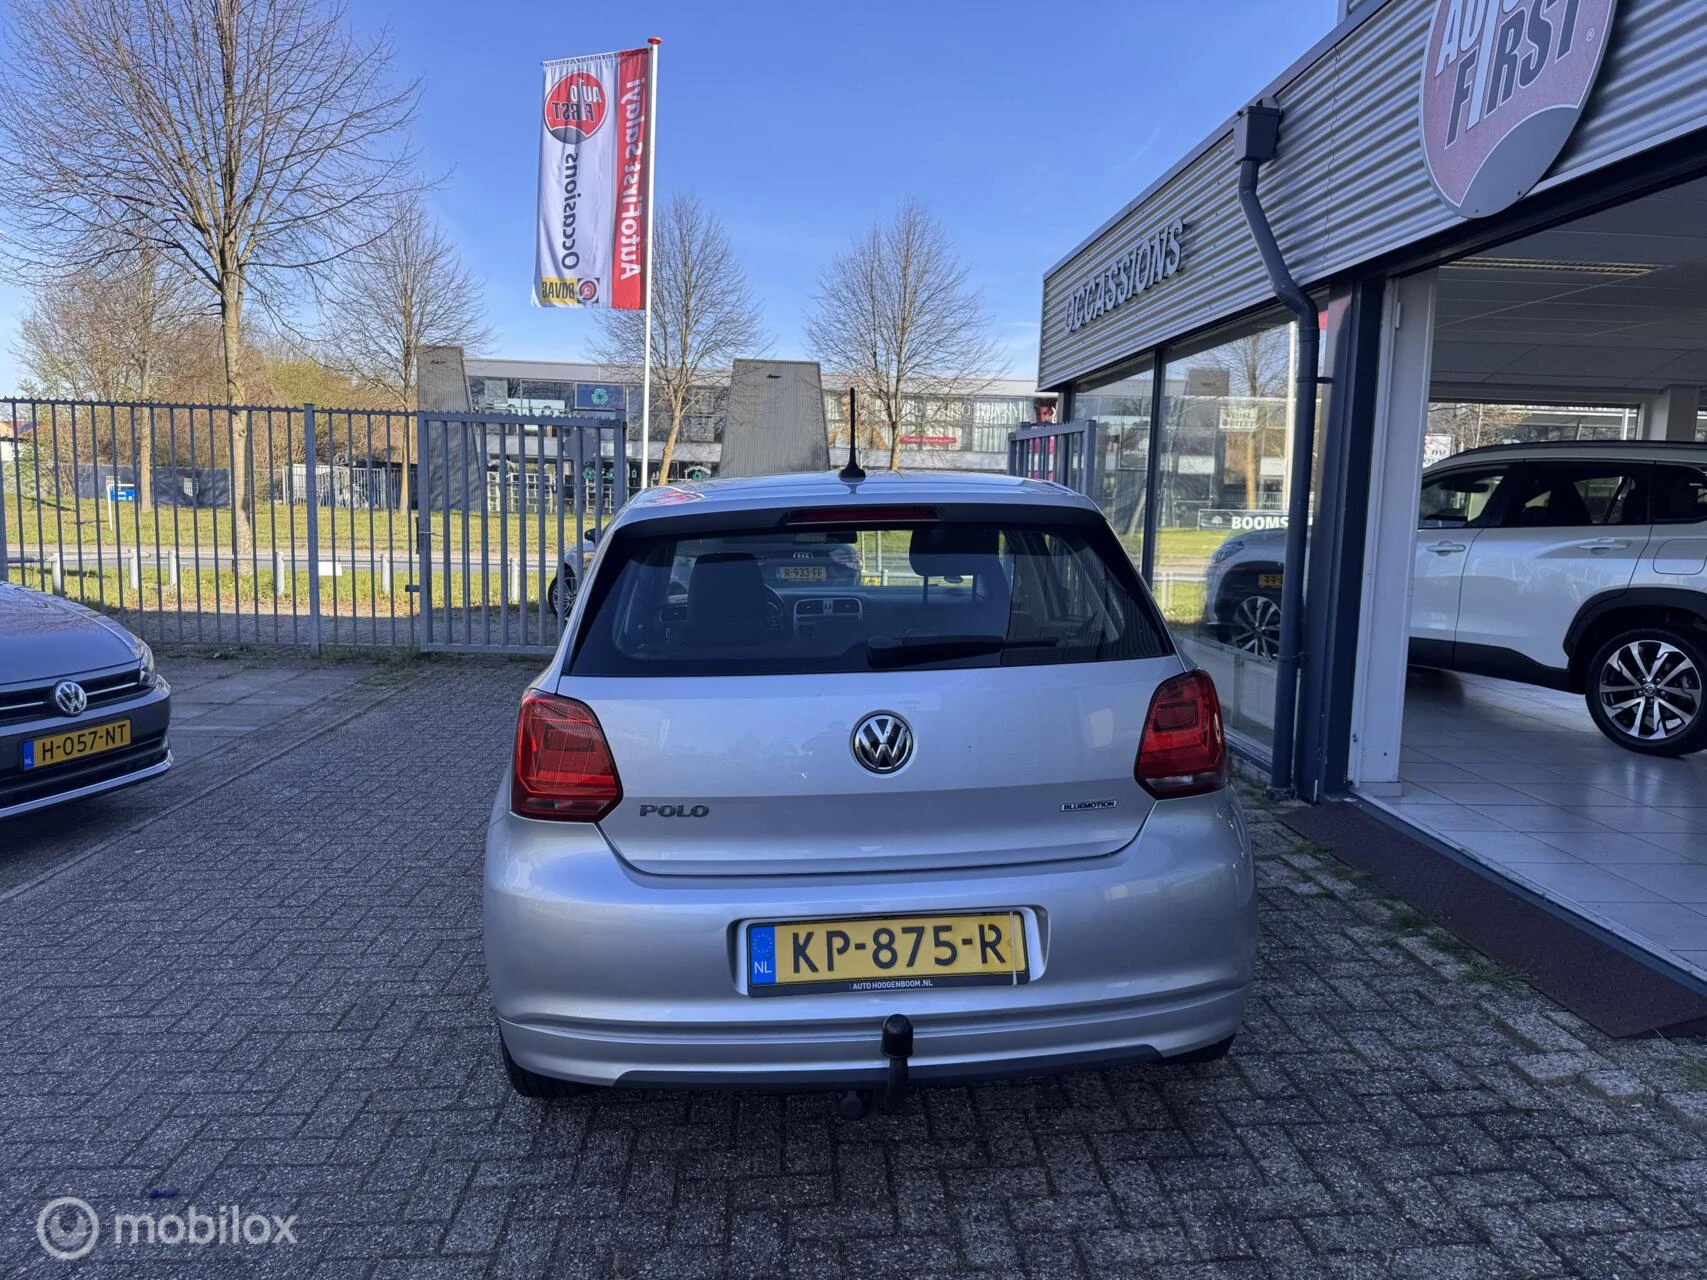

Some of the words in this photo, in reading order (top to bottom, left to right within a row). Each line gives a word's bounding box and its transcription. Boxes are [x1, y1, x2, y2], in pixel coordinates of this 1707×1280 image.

[1434, 0, 1520, 78] AUT
[1445, 0, 1580, 149] FIRST
[1065, 218, 1184, 332] OCCASSIONS
[1231, 516, 1289, 530] BOOMS
[42, 723, 127, 762] H-057-NT
[639, 803, 710, 818] POLO
[1063, 800, 1116, 810] BLUEMOTION
[754, 960, 772, 974] NL
[791, 923, 1006, 974] KP-875-R
